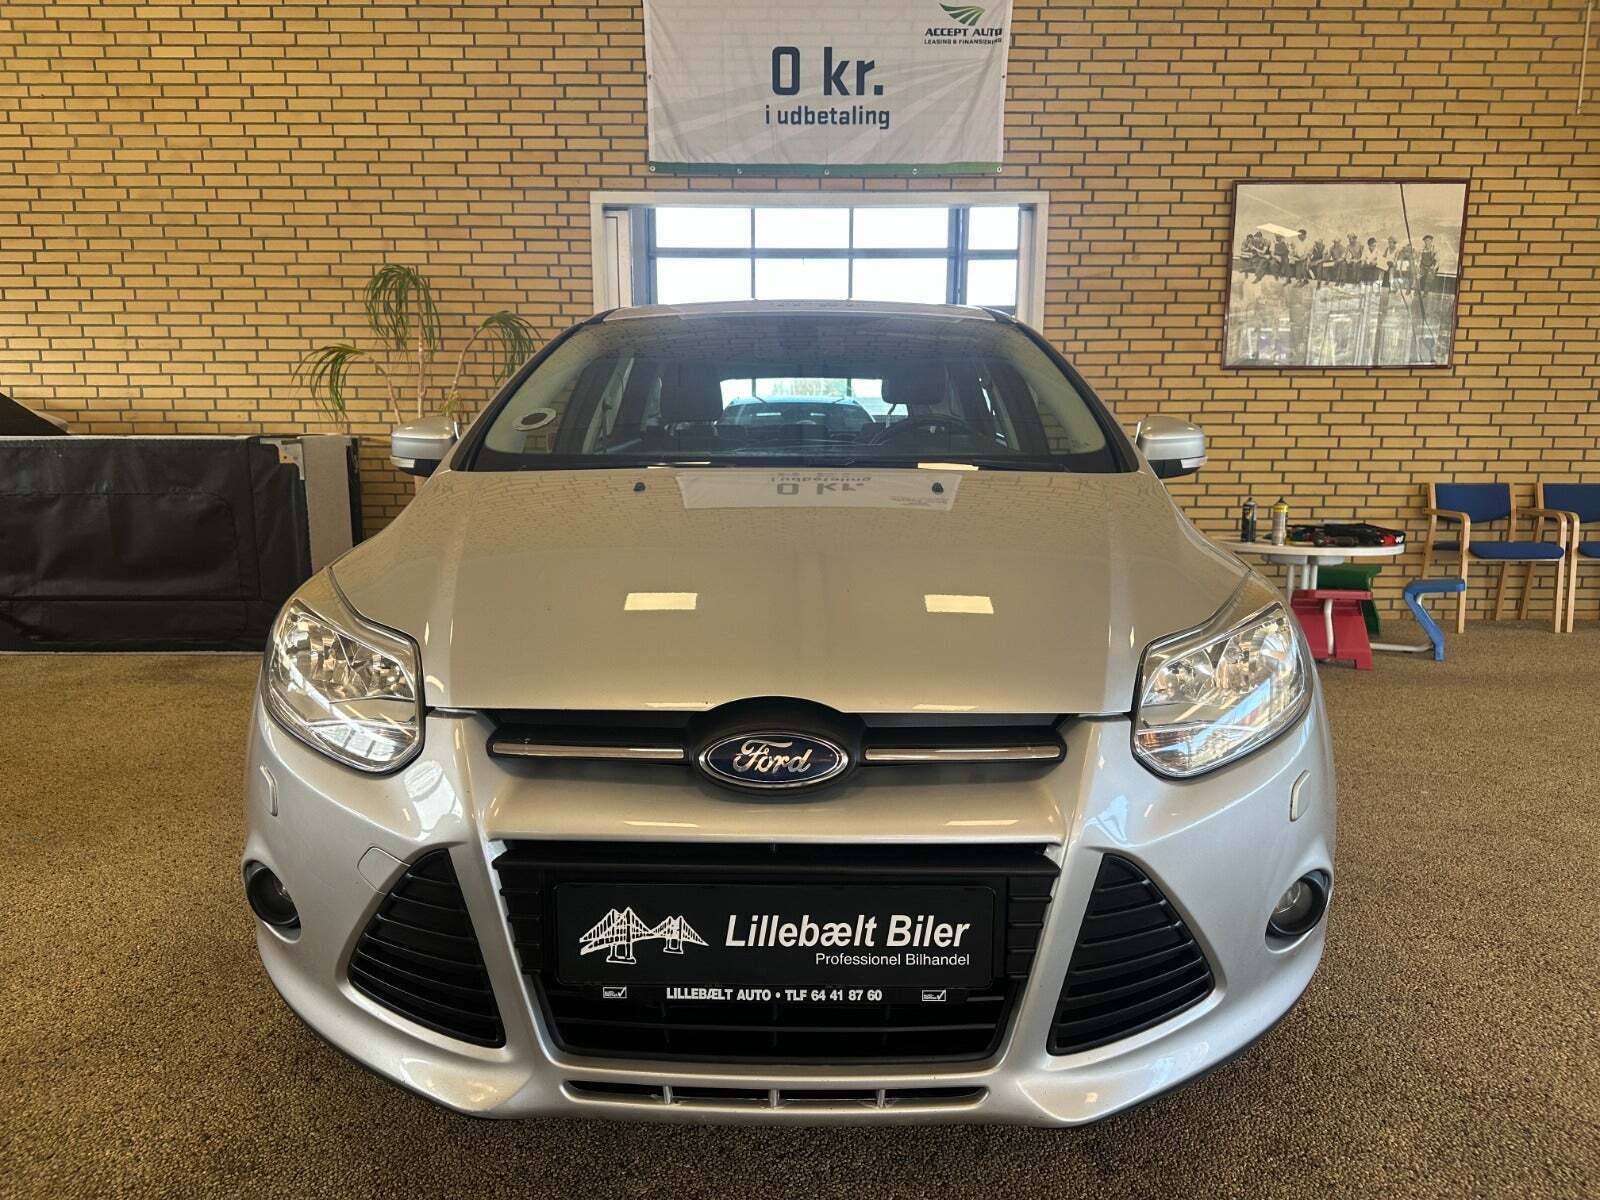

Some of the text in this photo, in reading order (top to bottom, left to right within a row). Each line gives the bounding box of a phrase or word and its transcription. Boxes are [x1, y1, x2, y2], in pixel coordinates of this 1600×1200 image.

[925, 28, 1003, 37] ACCEPT AUTO
[772, 46, 884, 95] 0 kr.
[765, 104, 890, 130] i udbetaling
[732, 739, 813, 773] Ford
[725, 914, 971, 947] Lillebælt Biler
[815, 952, 970, 966] Professionel Bilhandel
[666, 987, 883, 1001] LILLEBÆLT AUTO TLF 64 41 87 60
